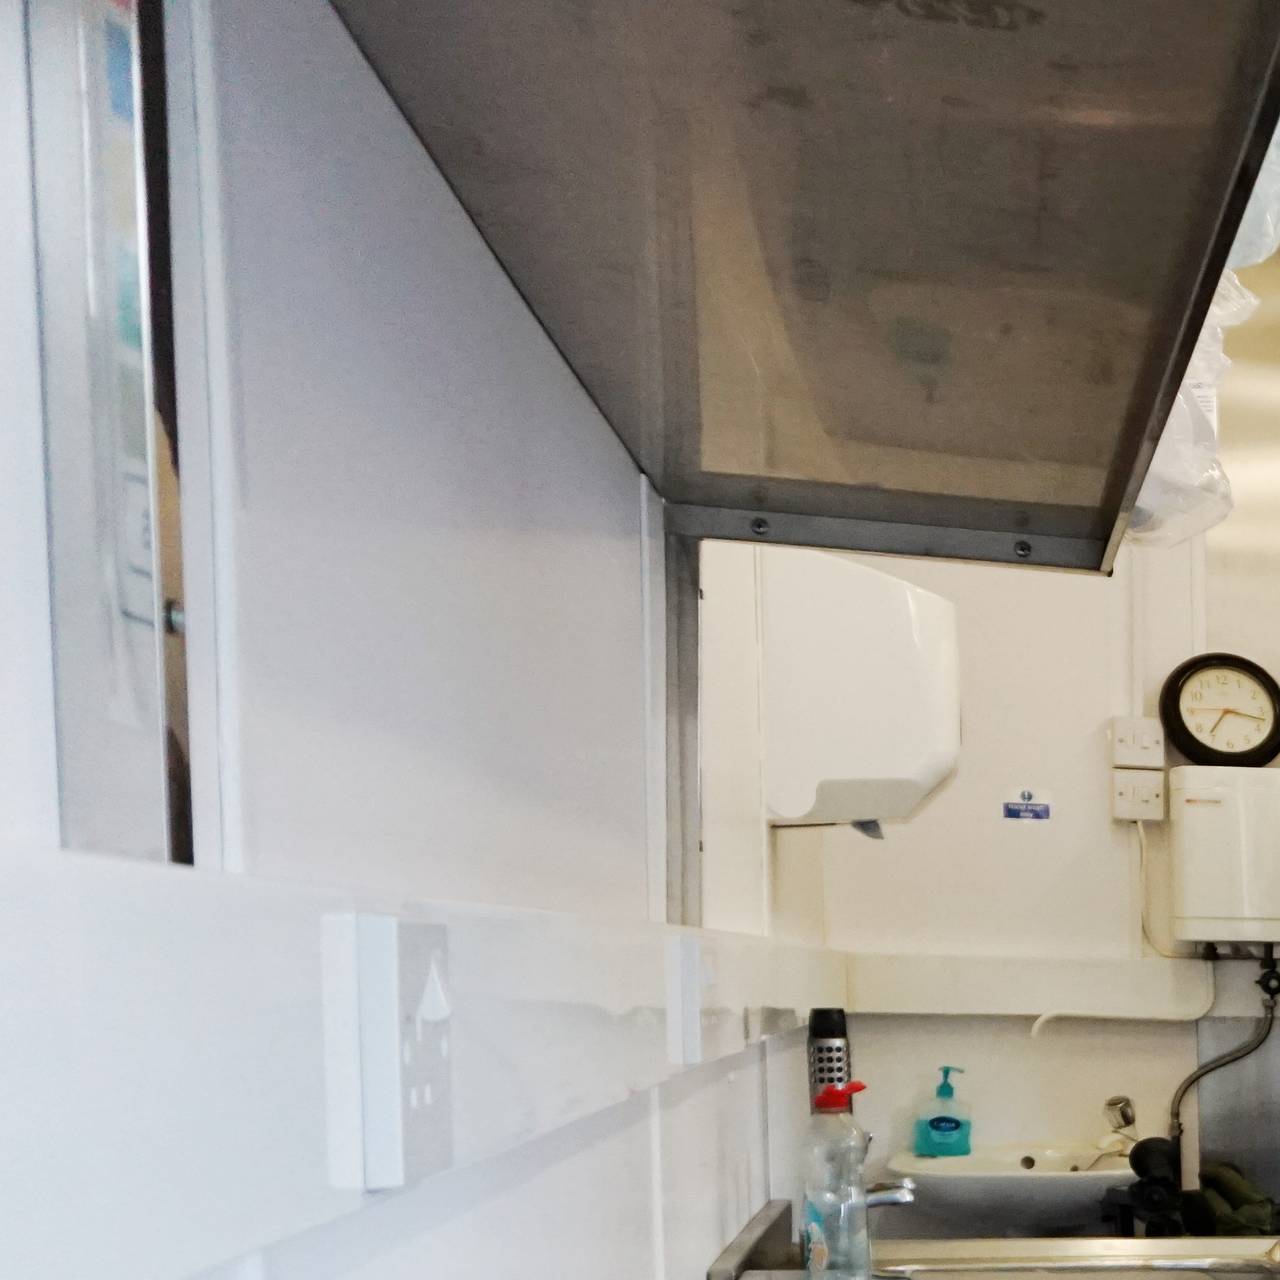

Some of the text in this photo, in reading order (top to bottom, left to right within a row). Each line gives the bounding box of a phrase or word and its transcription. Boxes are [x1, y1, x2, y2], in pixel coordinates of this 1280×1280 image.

[1200, 680, 1210, 689] 11
[1216, 674, 1228, 685] 12
[1190, 691, 1202, 701] 10
